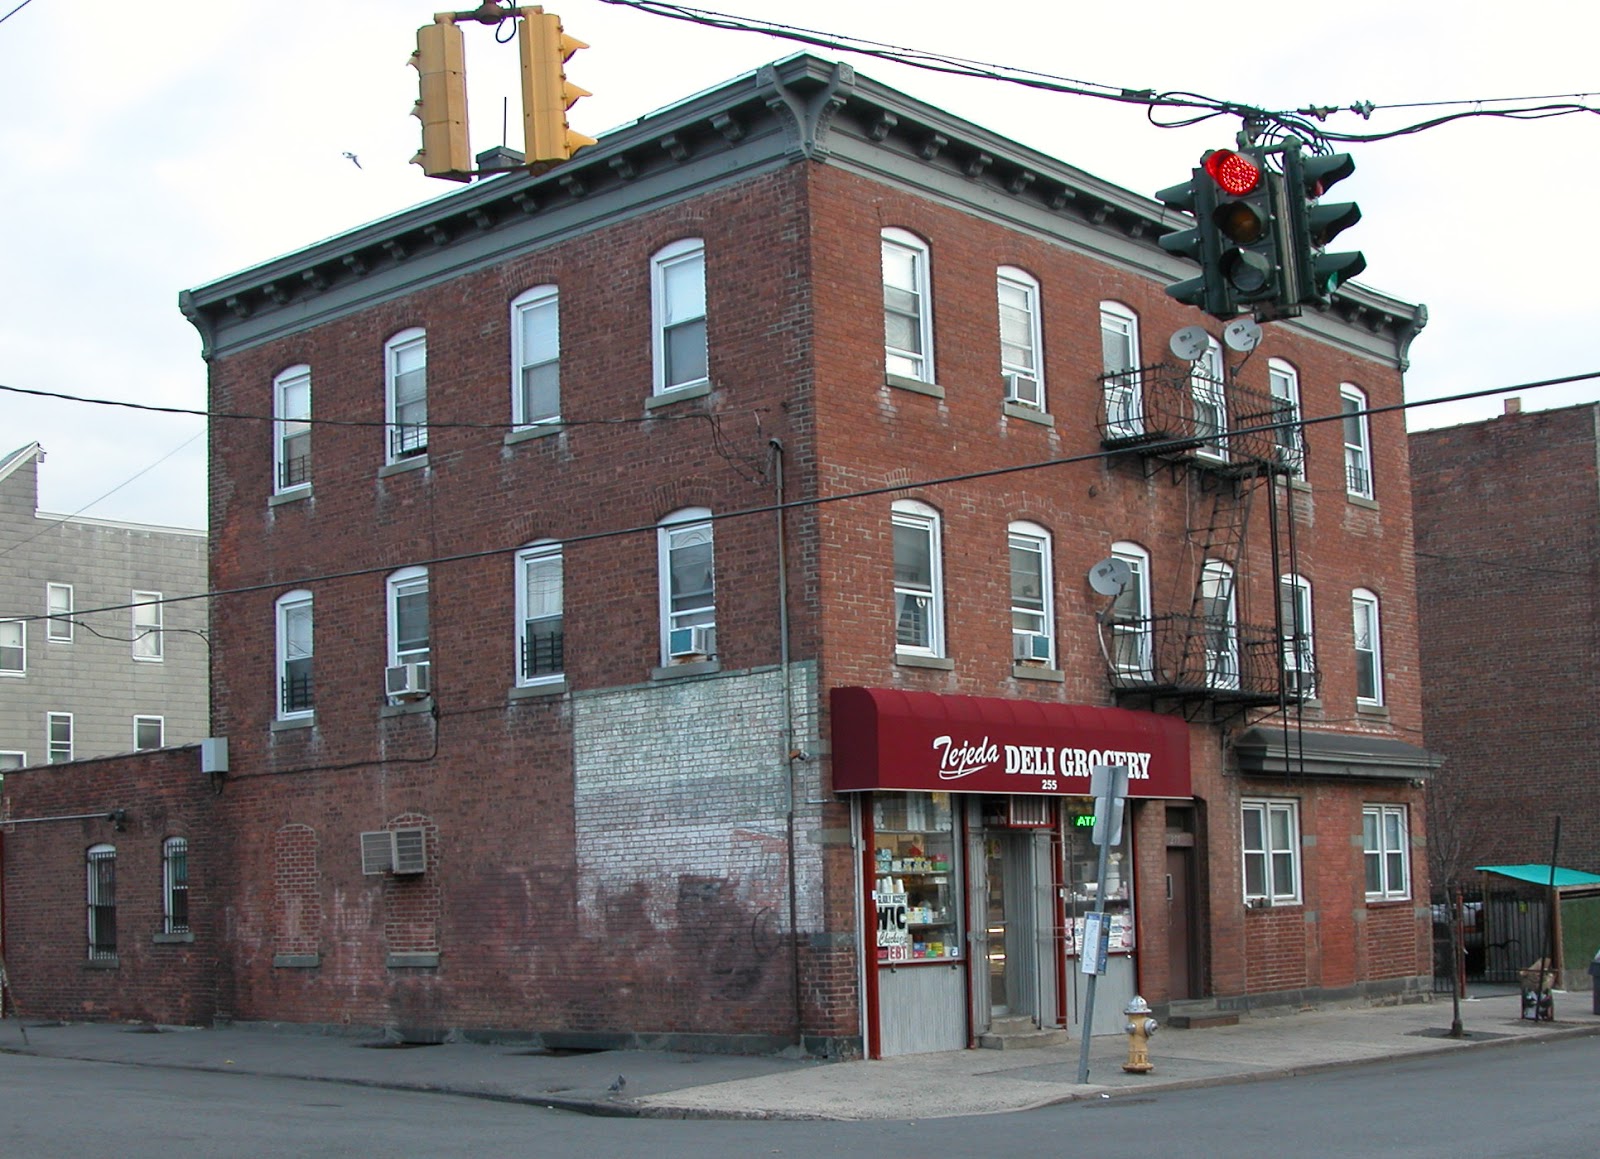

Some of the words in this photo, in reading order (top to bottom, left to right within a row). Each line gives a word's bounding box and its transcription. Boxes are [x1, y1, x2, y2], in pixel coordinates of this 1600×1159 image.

[933, 735, 1000, 776] Tejeda
[1004, 745, 1056, 775] DELI
[1041, 779, 1057, 791] 255
[890, 946, 907, 959] EBT
